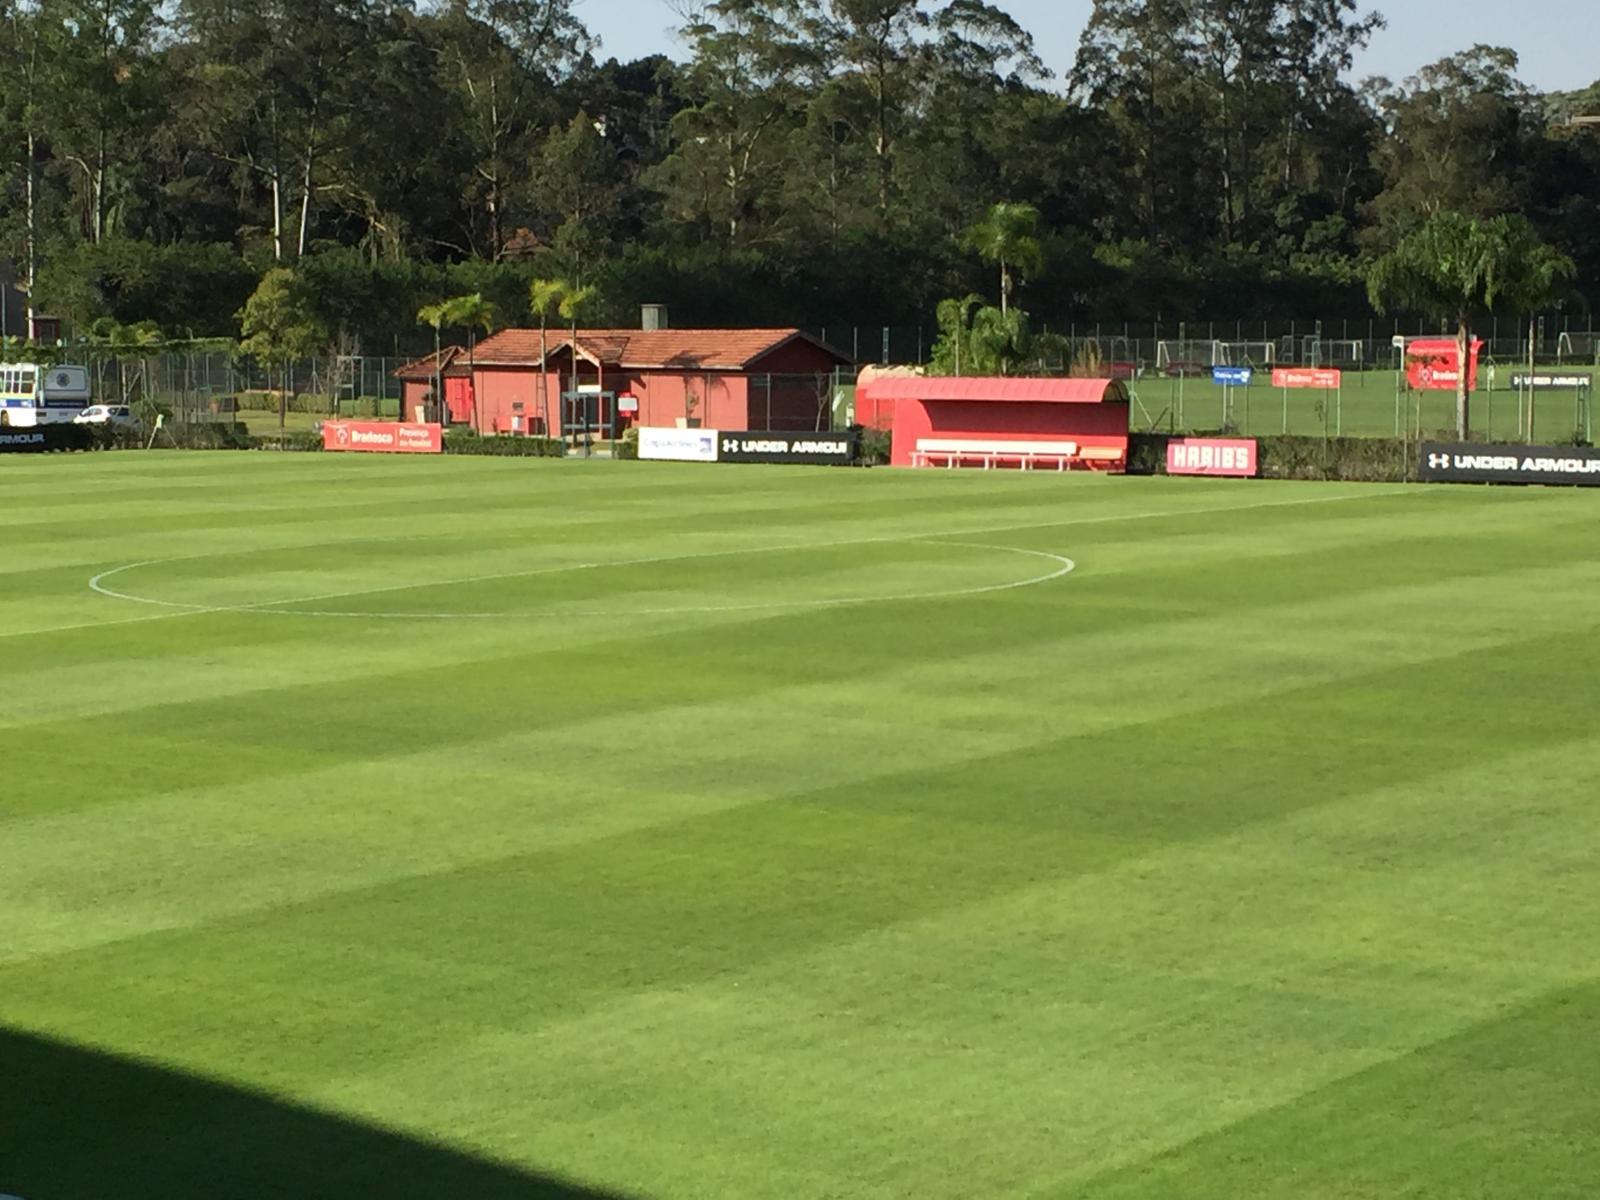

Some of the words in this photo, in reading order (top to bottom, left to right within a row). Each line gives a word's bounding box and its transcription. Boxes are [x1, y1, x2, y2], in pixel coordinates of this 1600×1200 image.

[351, 430, 394, 443] Bradesco
[742, 440, 788, 453] UNDER
[1173, 445, 1249, 469] HABIB'S
[1454, 455, 1518, 470] UNDER
[1521, 457, 1600, 473] ARMOUR
